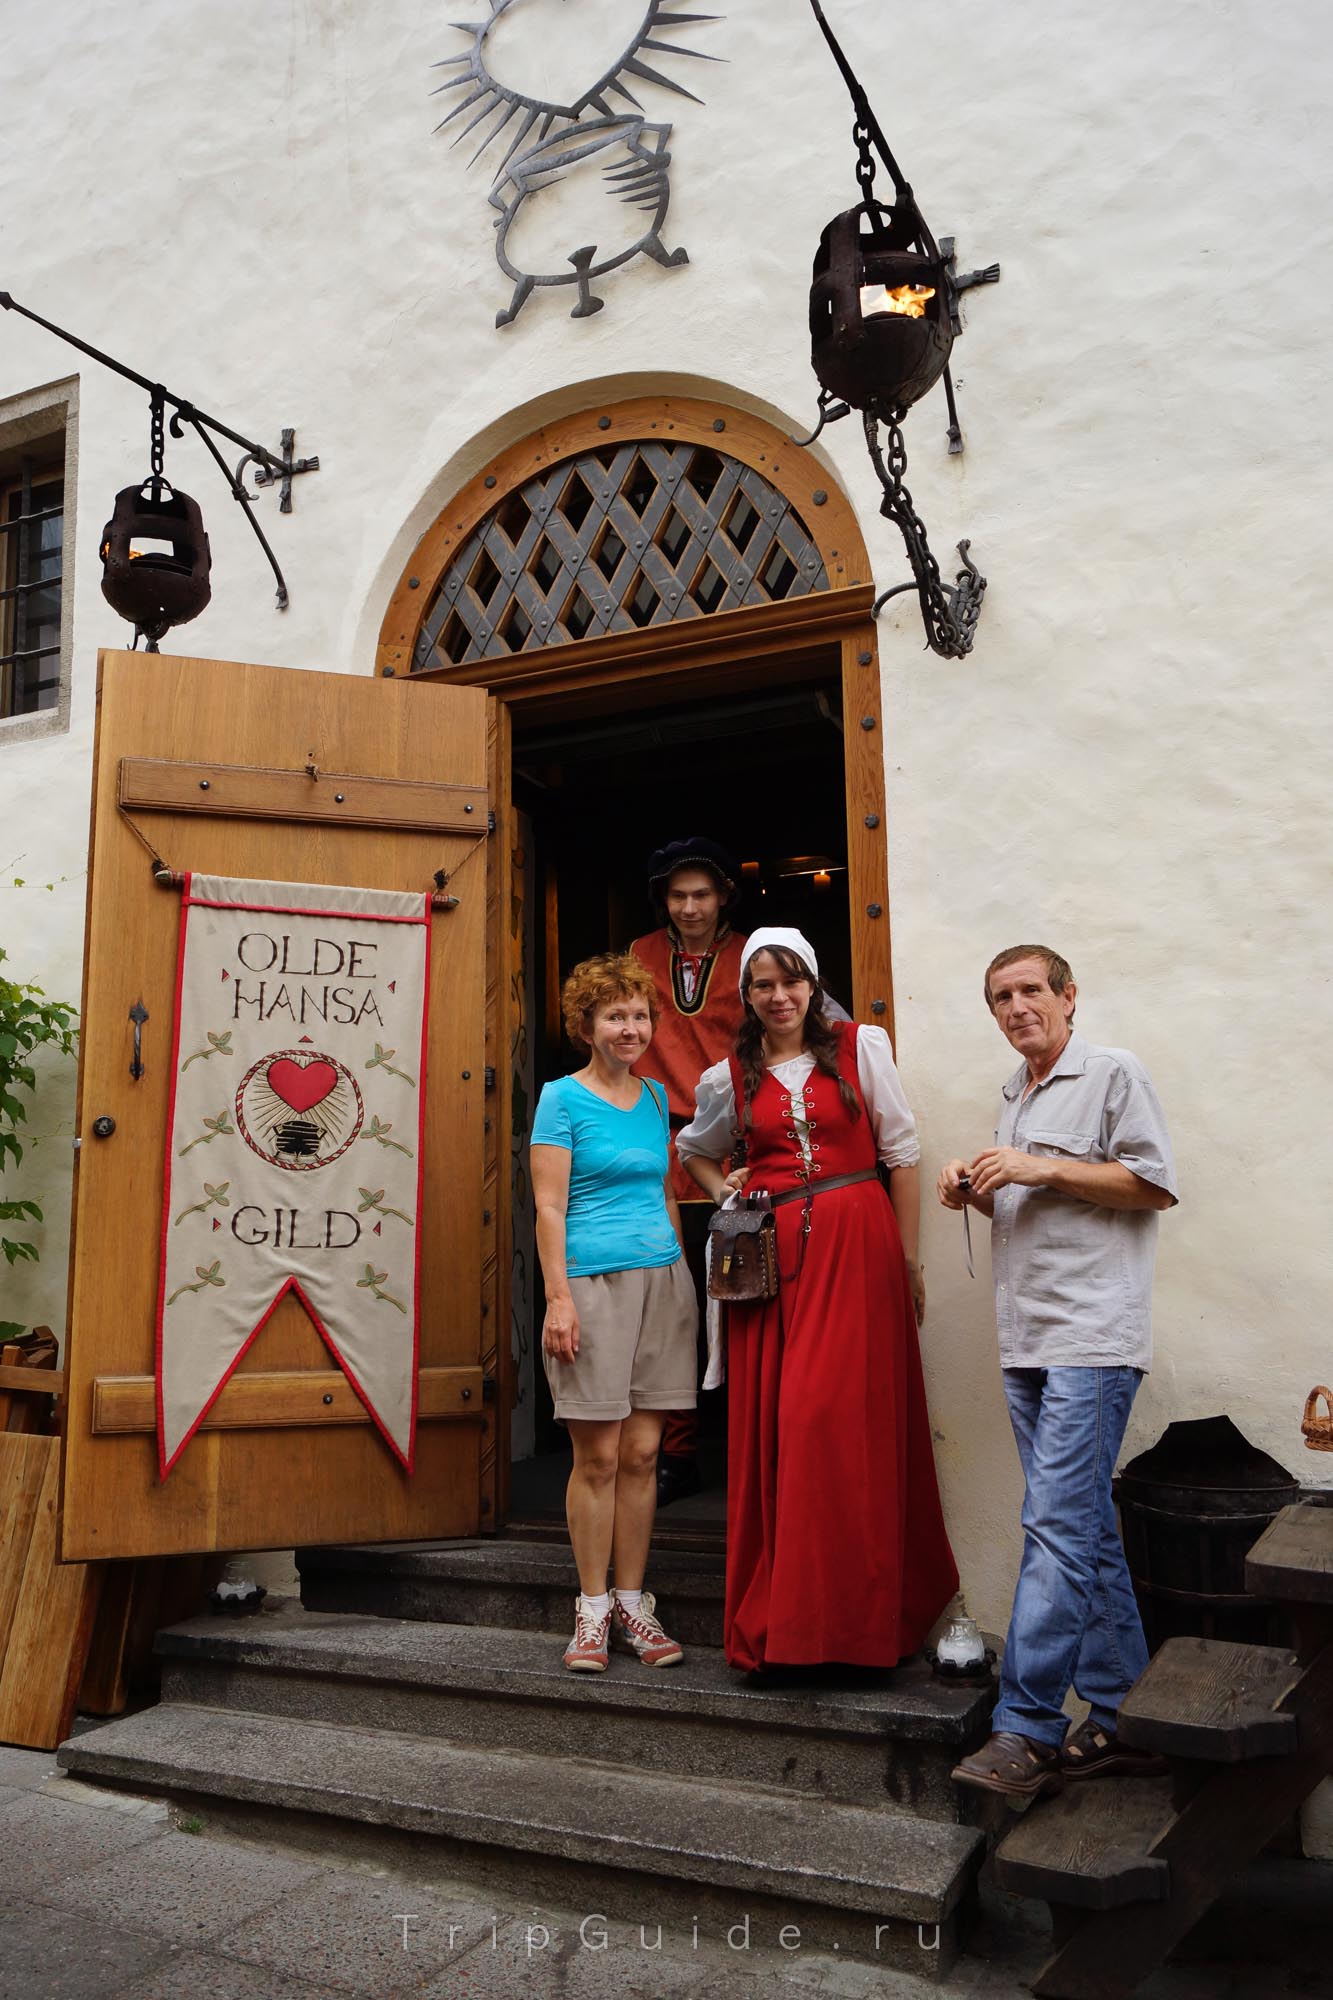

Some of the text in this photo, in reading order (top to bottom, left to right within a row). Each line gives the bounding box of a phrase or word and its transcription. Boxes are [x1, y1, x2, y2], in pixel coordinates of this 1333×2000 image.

[237, 932, 378, 979] OLDE
[232, 978, 384, 1028] HANSA
[231, 1205, 361, 1249] GILD
